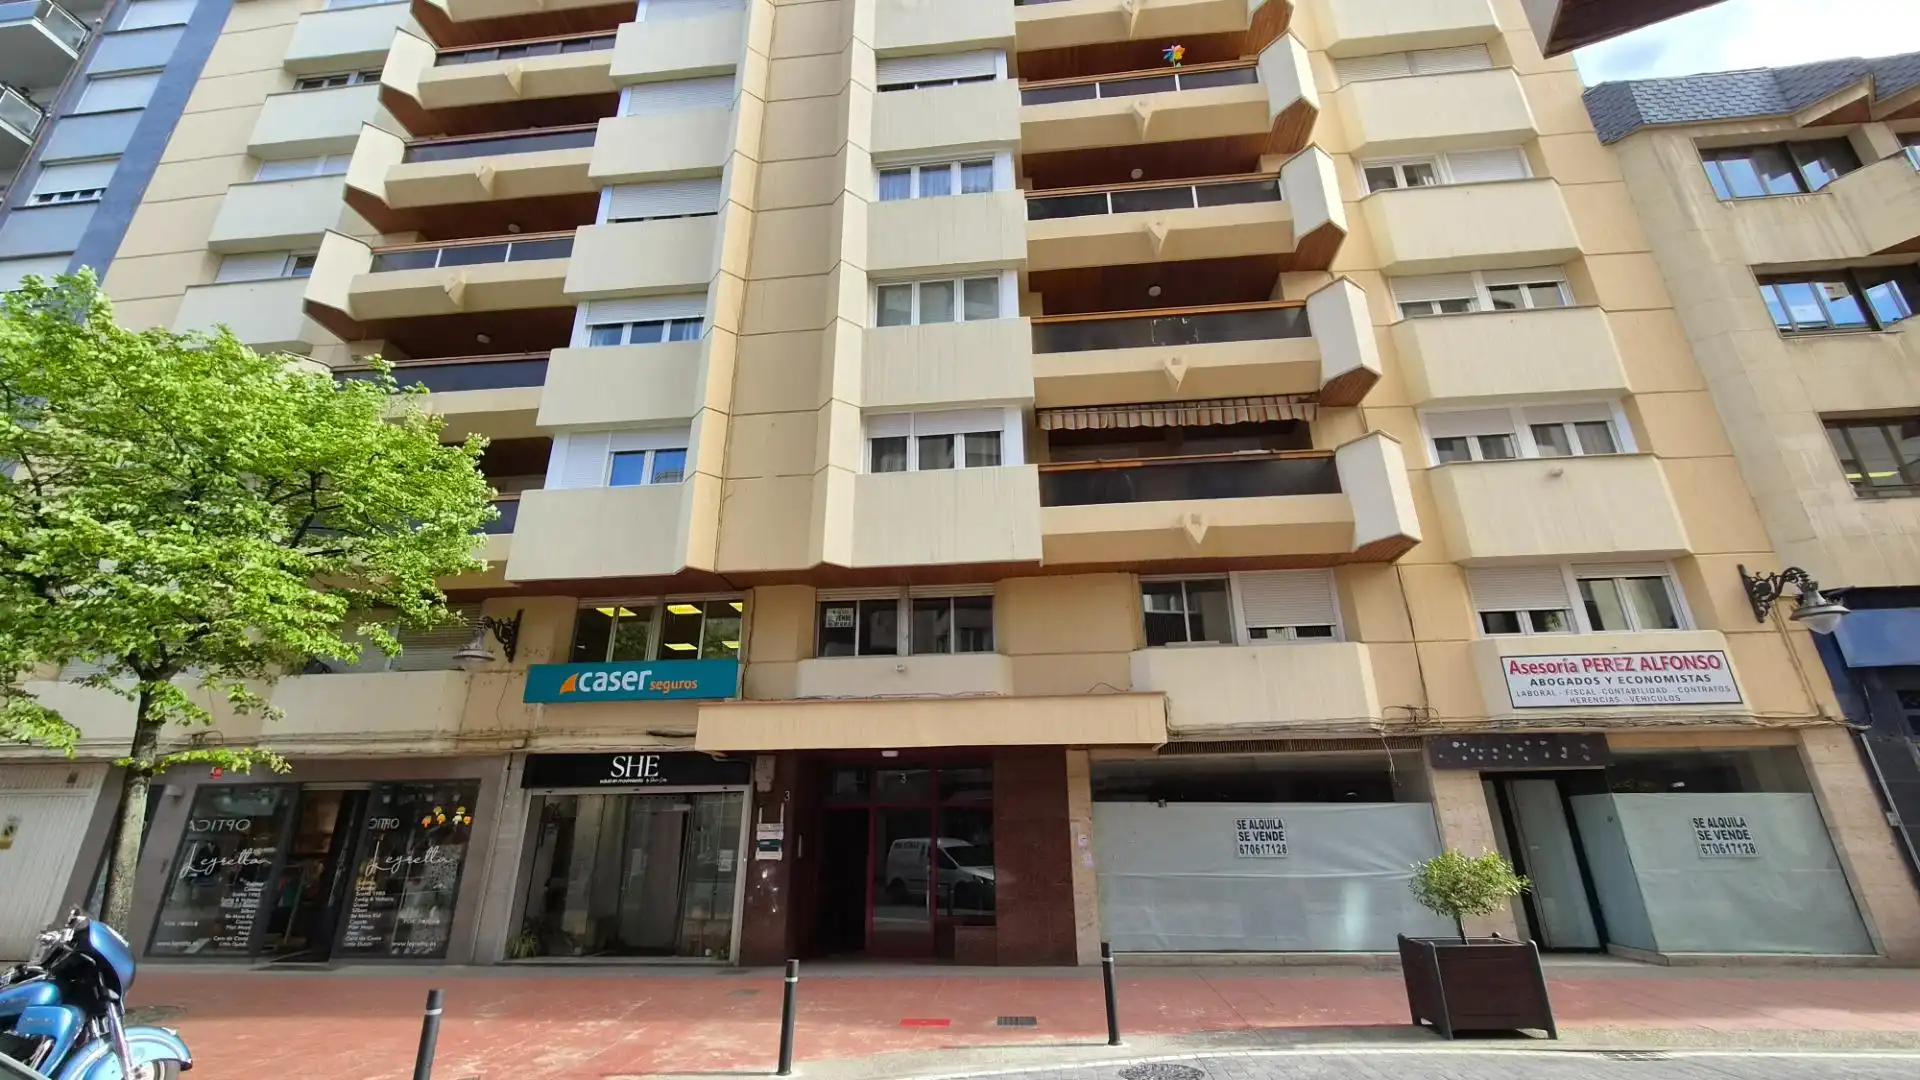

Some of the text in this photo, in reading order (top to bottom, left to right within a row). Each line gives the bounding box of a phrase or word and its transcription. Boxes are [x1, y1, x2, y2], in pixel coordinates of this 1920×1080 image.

[1581, 656, 1637, 673] PEREZ
[1639, 654, 1722, 671] ALFONSO
[578, 670, 698, 694] caser seguros
[1530, 674, 1712, 686] ABOGADOS Y ECONOMISTAS
[1516, 685, 1731, 697] LABORAL FISCAL CONTABILIDAD CONTRATOS
[1569, 696, 1621, 704] HERENCIAS
[610, 754, 661, 778] SHE
[900, 773, 906, 783] 3
[784, 790, 790, 801] 3
[1236, 819, 1284, 830] SE ALQUILA
[1693, 816, 1747, 829] SE ALQUILA
[1238, 831, 1285, 842] SE VENDE
[1697, 829, 1751, 841] SE VENDE
[1239, 843, 1287, 855] 670617128
